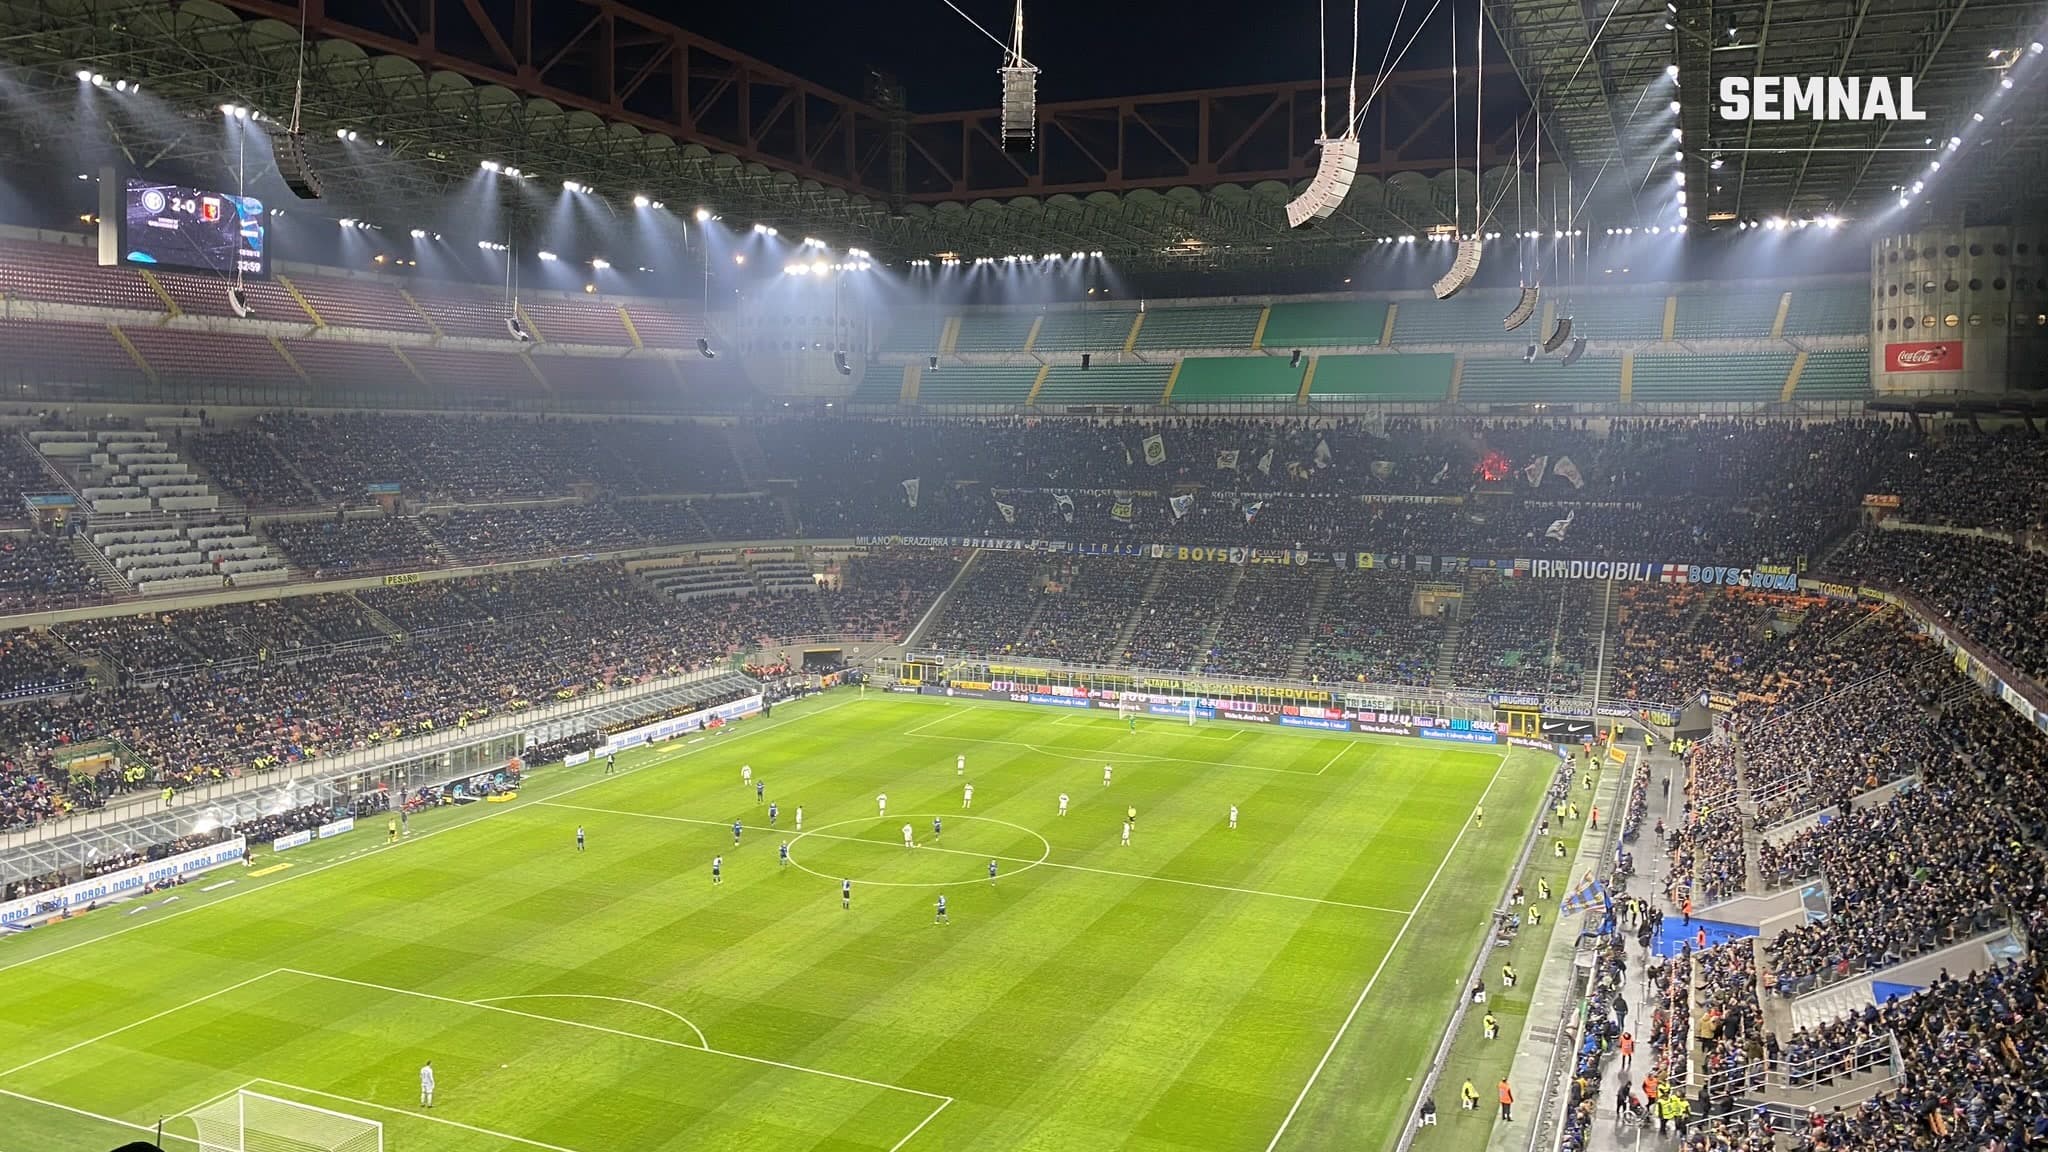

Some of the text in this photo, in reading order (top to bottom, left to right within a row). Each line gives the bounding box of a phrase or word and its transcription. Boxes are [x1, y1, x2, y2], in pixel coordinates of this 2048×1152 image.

[171, 197, 195, 213] 2-0
[856, 536, 890, 546] MILANO
[962, 538, 1022, 549] BRIANZA
[1067, 542, 1133, 555] ULTRAS
[1178, 547, 1229, 562] BOYS
[1688, 565, 1798, 591] BOYS ROMA
[1144, 678, 1180, 689] ALTAVILLA
[1500, 695, 1540, 705] BRUGHERIO
[1544, 705, 1591, 716] CIAMPINO
[1378, 713, 1410, 725] BUU
